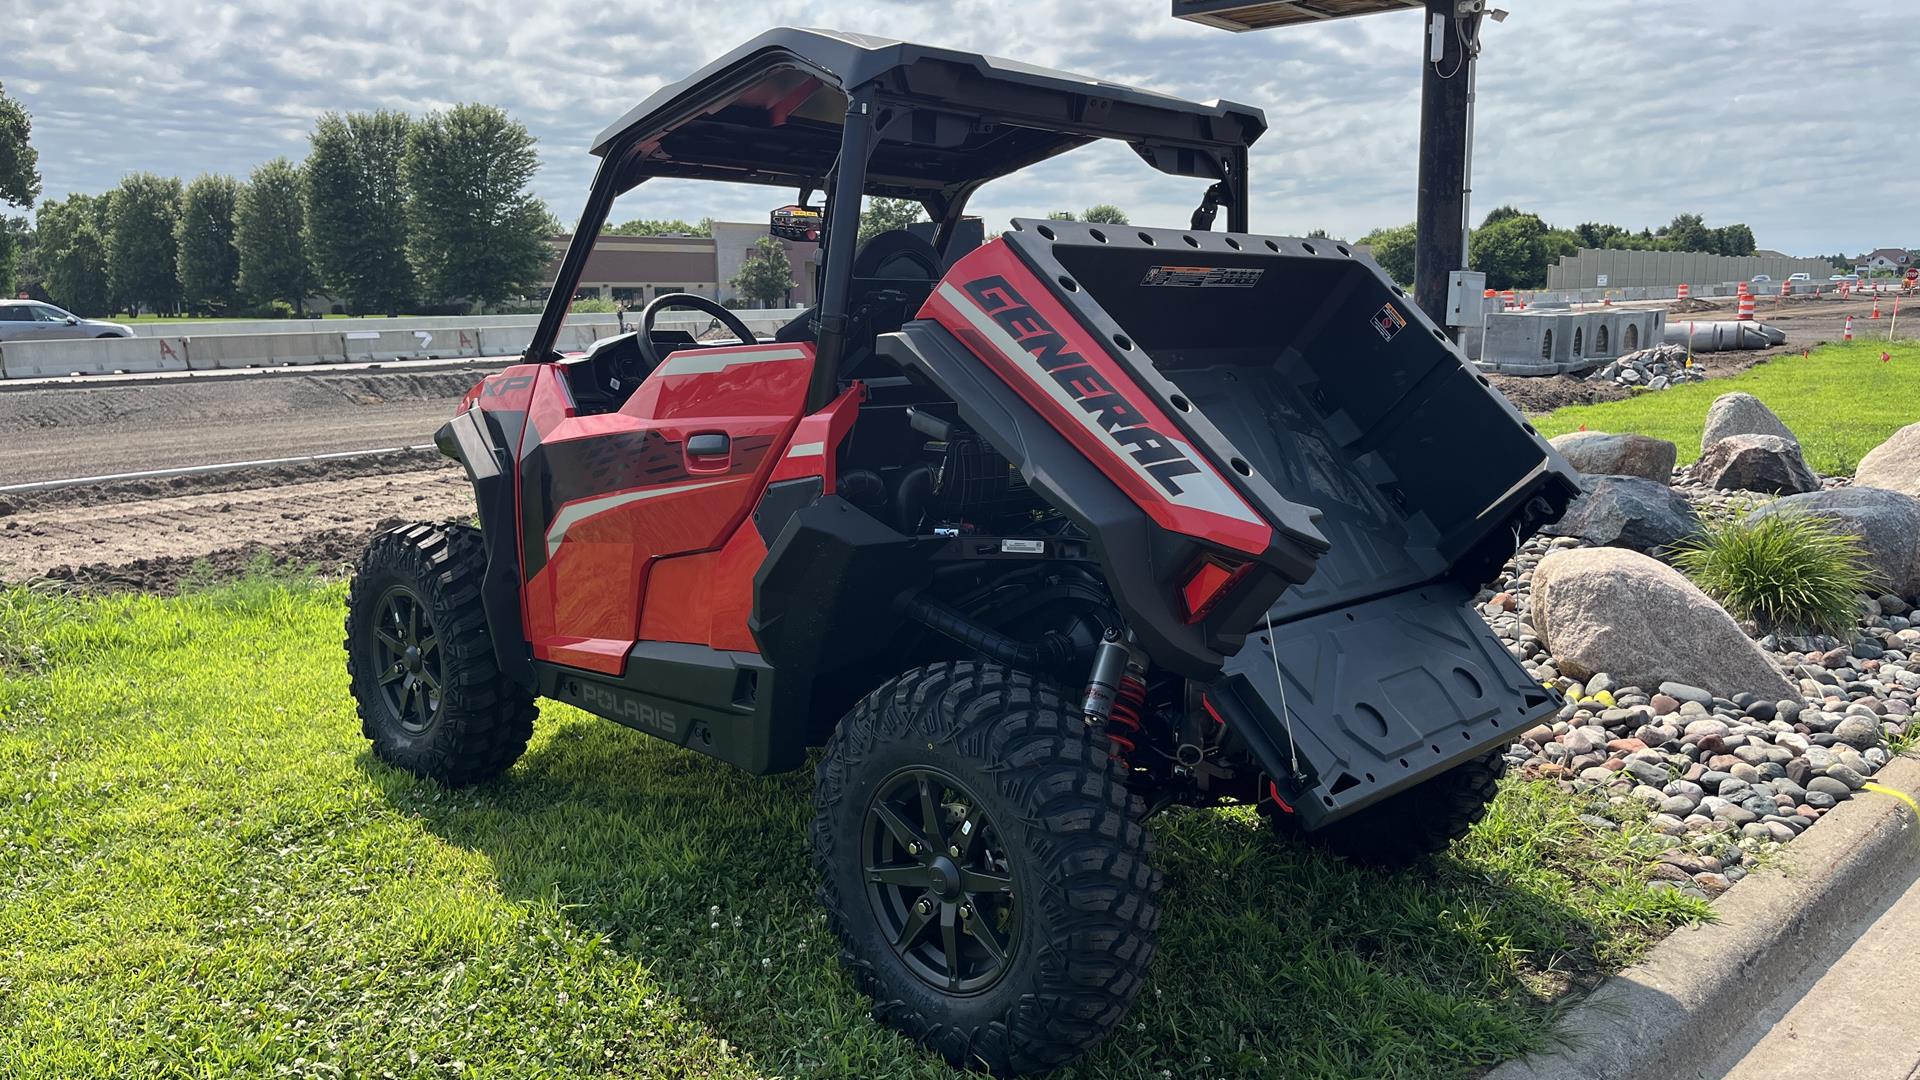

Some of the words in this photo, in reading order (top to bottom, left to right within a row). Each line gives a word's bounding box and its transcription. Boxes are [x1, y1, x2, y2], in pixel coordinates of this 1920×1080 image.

[160, 338, 180, 361] A
[459, 330, 473, 348] A
[485, 376, 534, 396] XP
[963, 275, 1202, 497] GENERAL
[583, 683, 676, 733] POLARIS
